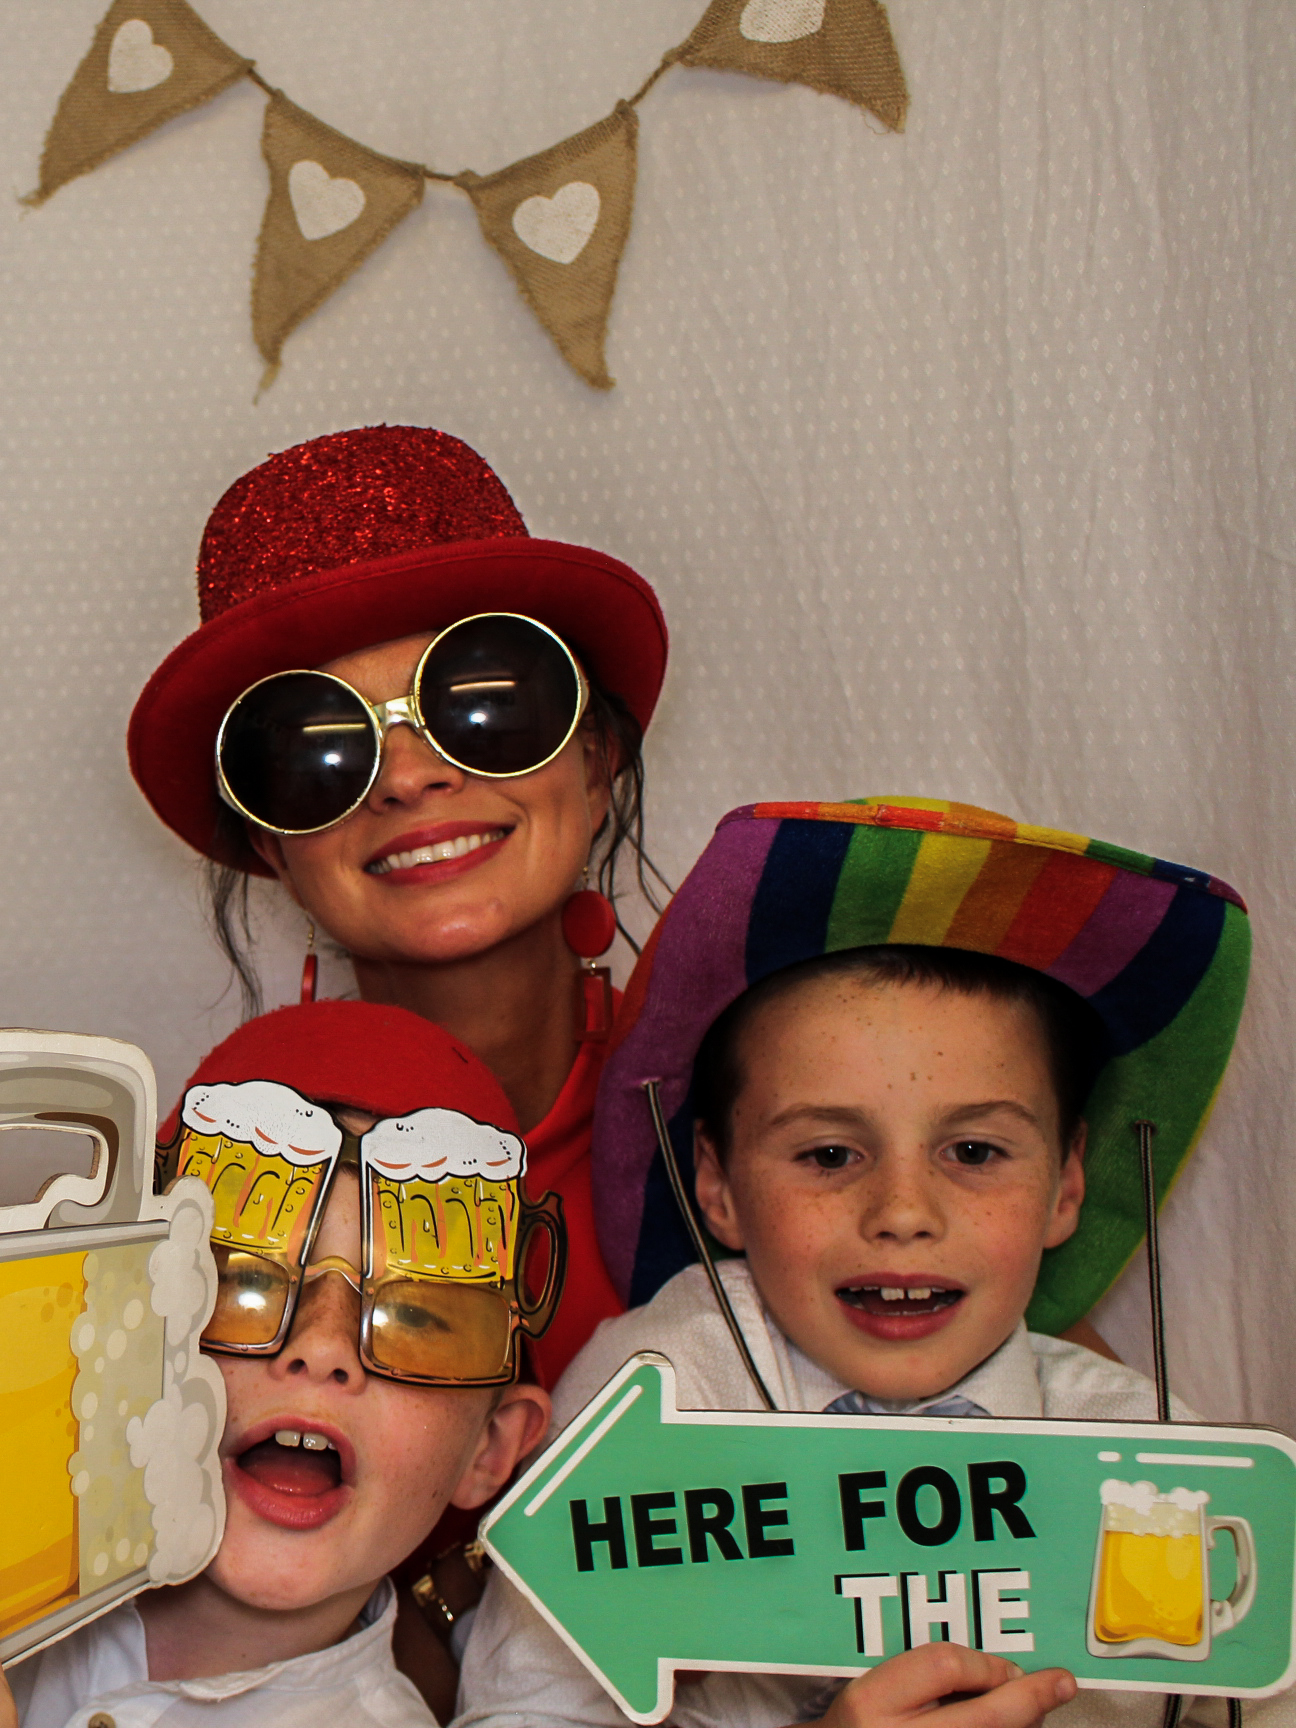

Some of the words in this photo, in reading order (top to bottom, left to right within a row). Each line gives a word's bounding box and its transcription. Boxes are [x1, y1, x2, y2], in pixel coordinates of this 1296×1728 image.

[569, 1481, 795, 1573] HERE
[837, 1459, 1036, 1552] FOR
[834, 1567, 1036, 1657] THE
